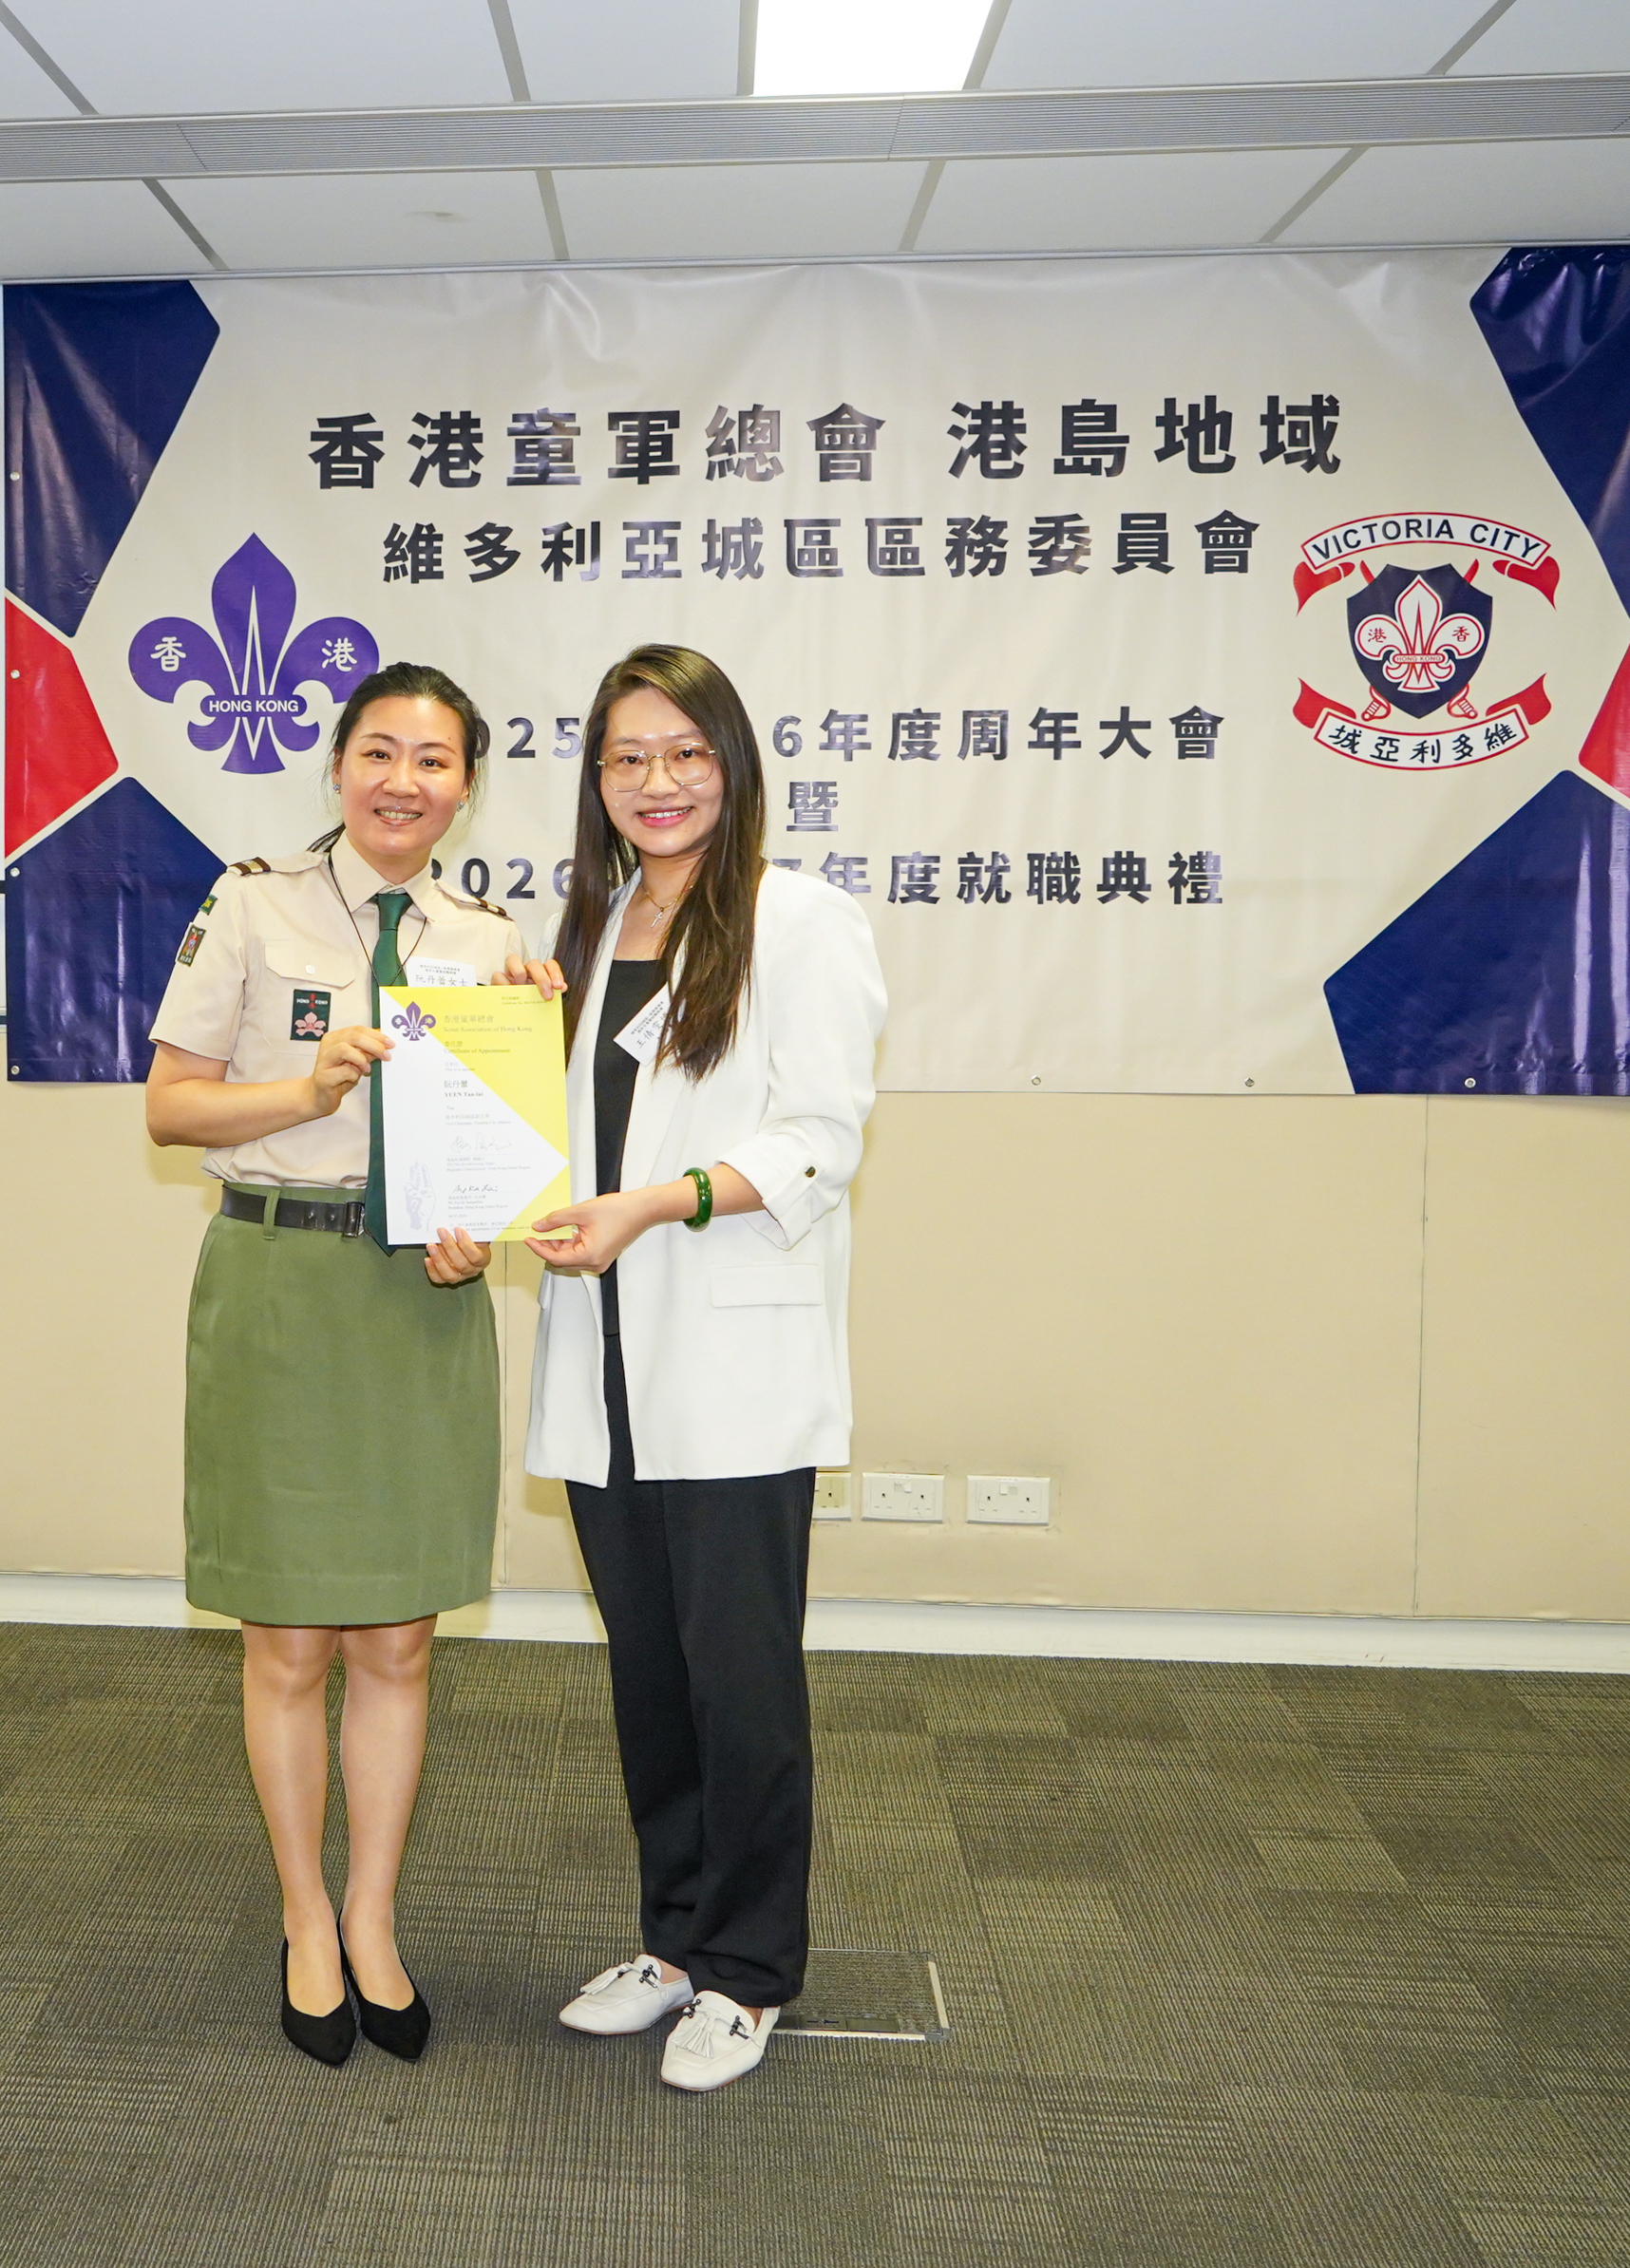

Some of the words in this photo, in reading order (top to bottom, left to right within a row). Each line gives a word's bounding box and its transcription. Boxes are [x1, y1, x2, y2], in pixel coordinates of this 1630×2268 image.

[308, 403, 886, 489] 香港童軍總會
[947, 393, 1341, 480] 港島地域
[383, 509, 1260, 583] 維多利亞城區區務委員會
[1312, 519, 1454, 560] VICTORIA
[1469, 523, 1542, 559] CITY
[150, 636, 186, 672] 香
[321, 637, 357, 672] 港
[209, 700, 252, 712] HONG
[256, 700, 299, 712] KONG
[787, 781, 839, 832] 暨
